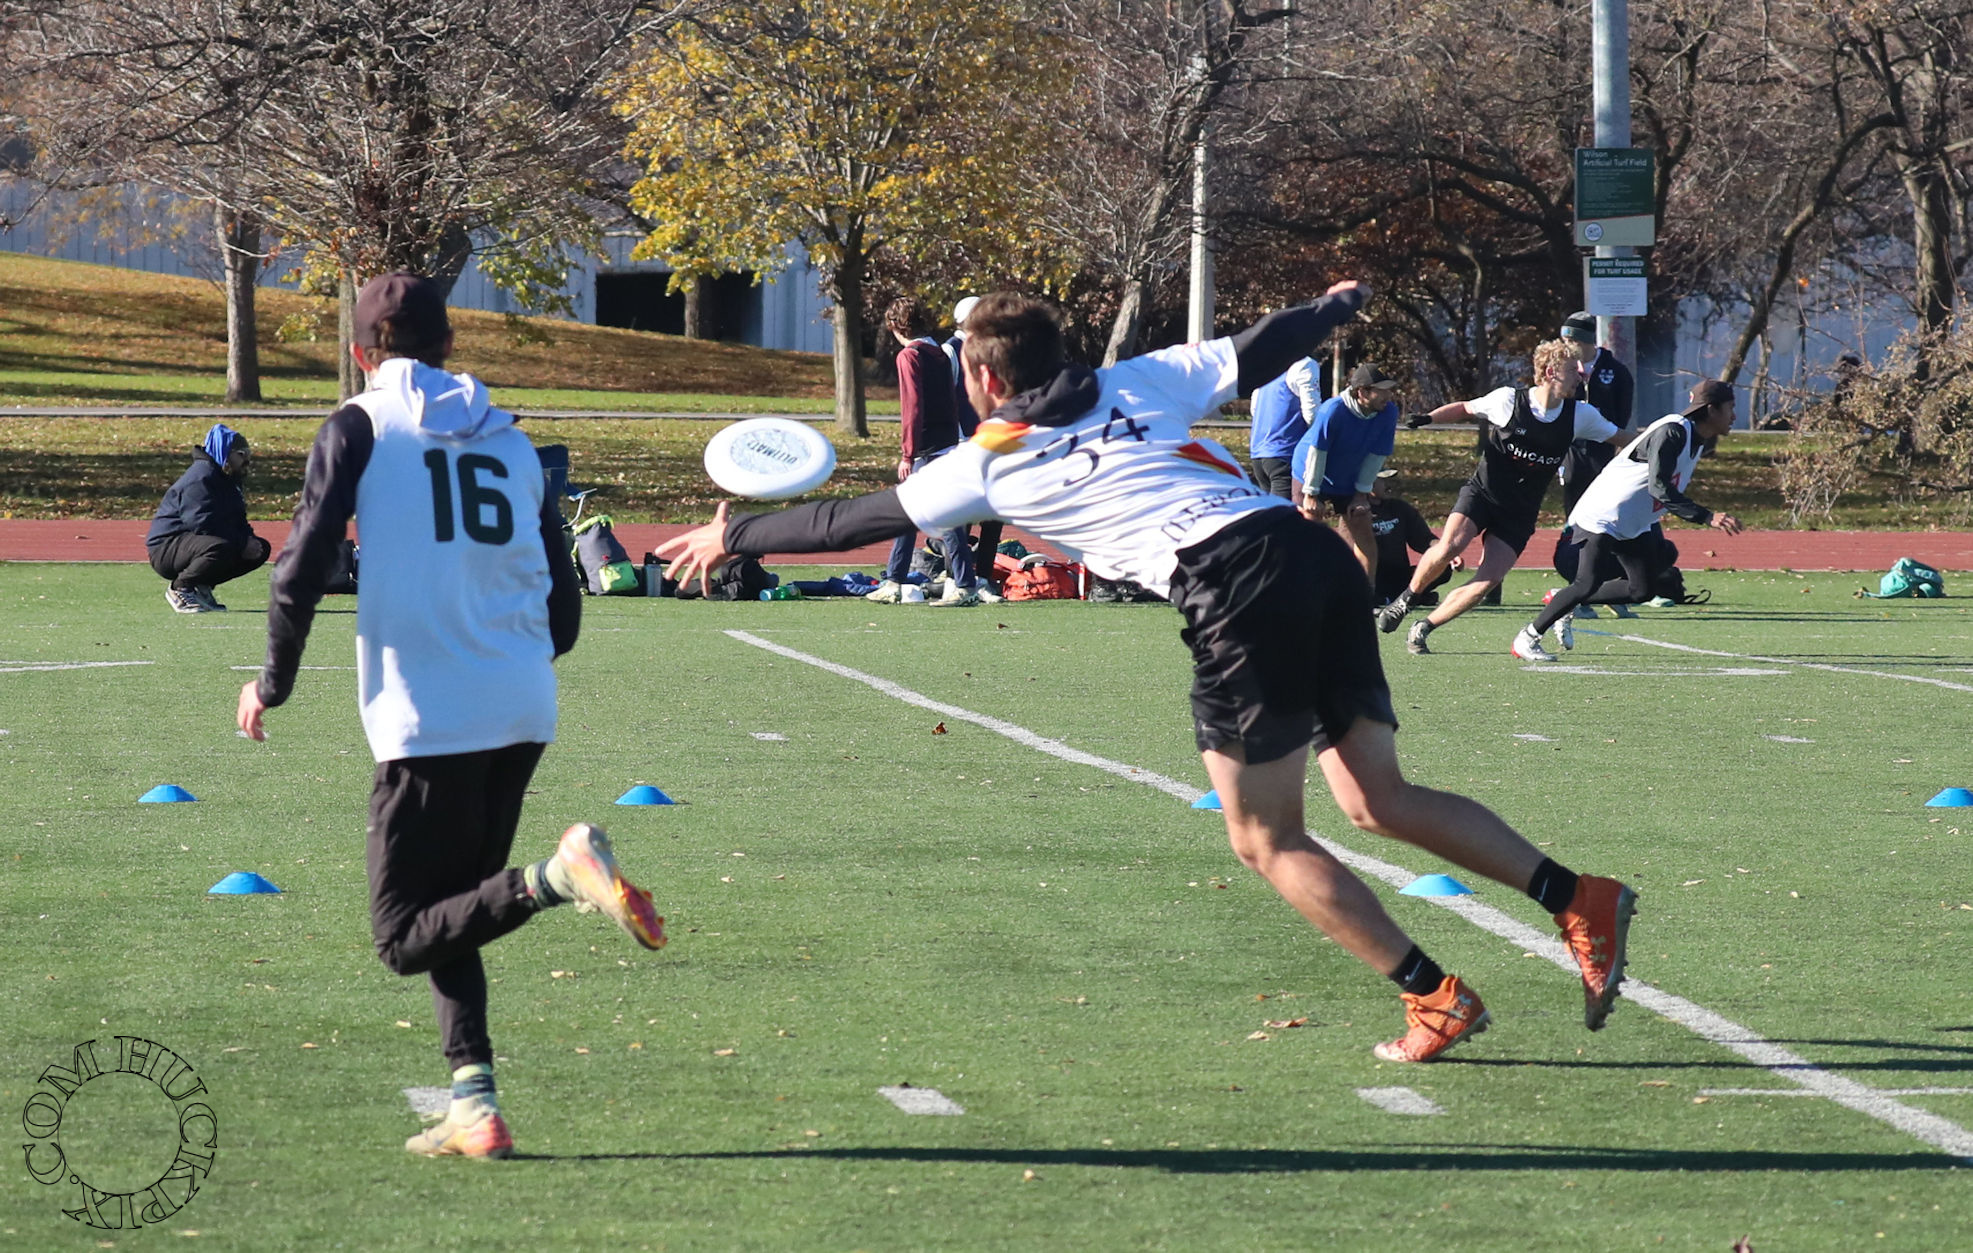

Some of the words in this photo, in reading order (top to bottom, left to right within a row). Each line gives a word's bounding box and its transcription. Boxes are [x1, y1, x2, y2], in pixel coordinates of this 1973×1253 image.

[1583, 158, 1612, 166] Artificial
[1614, 158, 1628, 166] Turf
[1629, 158, 1647, 166] Field
[1035, 406, 1151, 487] 34
[1507, 443, 1561, 465] CHICAGO
[423, 448, 514, 546] 16
